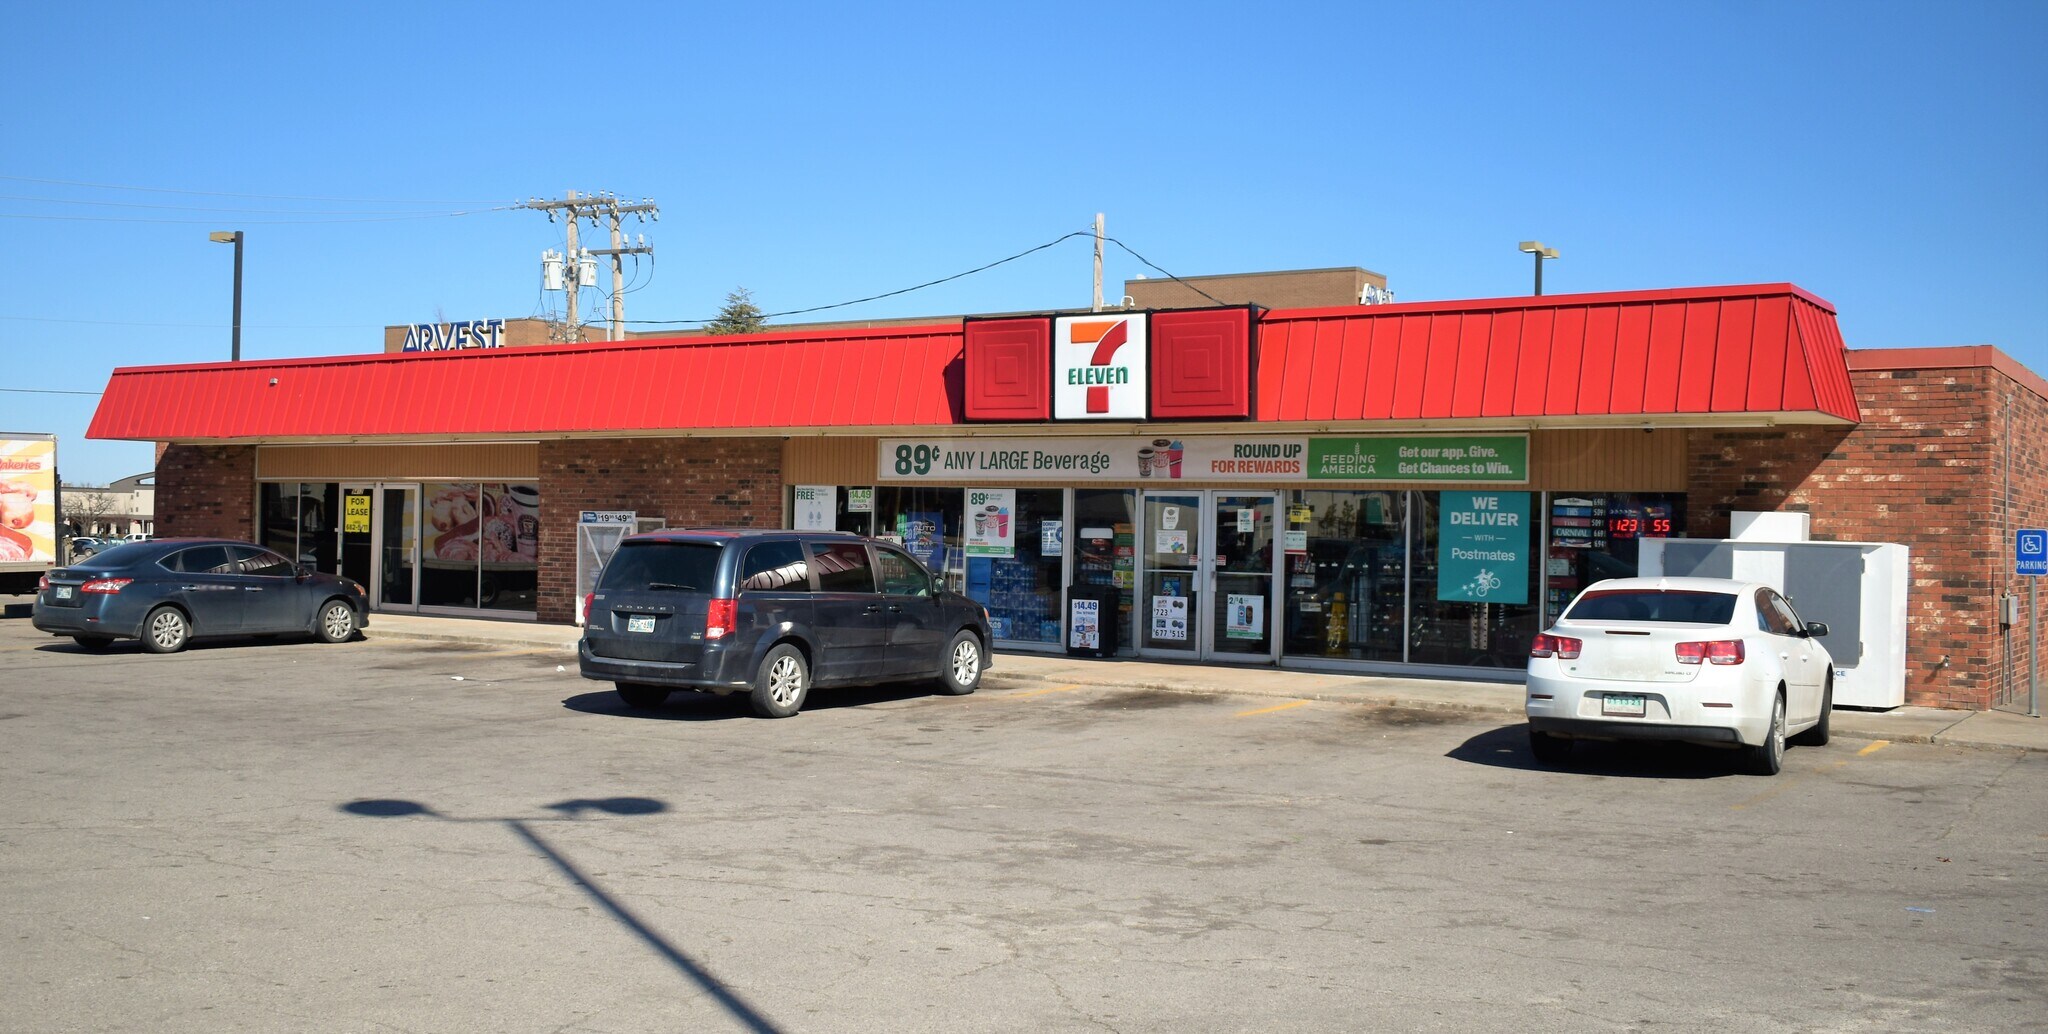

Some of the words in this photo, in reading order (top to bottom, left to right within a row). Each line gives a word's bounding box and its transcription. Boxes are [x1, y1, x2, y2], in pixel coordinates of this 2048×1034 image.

[402, 318, 505, 352] ARVEST
[1071, 319, 1128, 413] 7
[1234, 444, 1280, 458] ROUND
[1283, 444, 1302, 458] UP
[1399, 446, 1419, 458] Get
[1421, 448, 1440, 458] our
[1442, 448, 1467, 460] app.
[1469, 446, 1498, 457] Give.
[0, 458, 41, 470] akeries
[895, 444, 940, 475] 89¢
[944, 451, 975, 470] ANY
[980, 451, 1029, 470] LARGE
[1033, 451, 1110, 474] Beverage
[1322, 454, 1376, 464] FEEDING
[1212, 460, 1235, 473] FOR
[1238, 460, 1300, 474] REWARDS
[1321, 464, 1376, 474] AMERICA
[1398, 462, 1418, 474] Get
[1420, 462, 1471, 474] Chances
[1472, 463, 1485, 474] to
[1487, 462, 1513, 474] Win.
[351, 497, 365, 505] FOR
[796, 491, 815, 500] FREE
[970, 492, 989, 505] 89¢
[1472, 496, 1498, 510] WE
[346, 508, 368, 516] LEASE
[1450, 511, 1519, 526] DELIVER
[1616, 519, 1638, 532] 123
[1653, 519, 1671, 532] 55
[1556, 528, 1588, 537] CARNIVAL
[1451, 547, 1516, 561] Postmates
[2016, 560, 2047, 570] PARKING
[1074, 601, 1098, 610] $14.49
